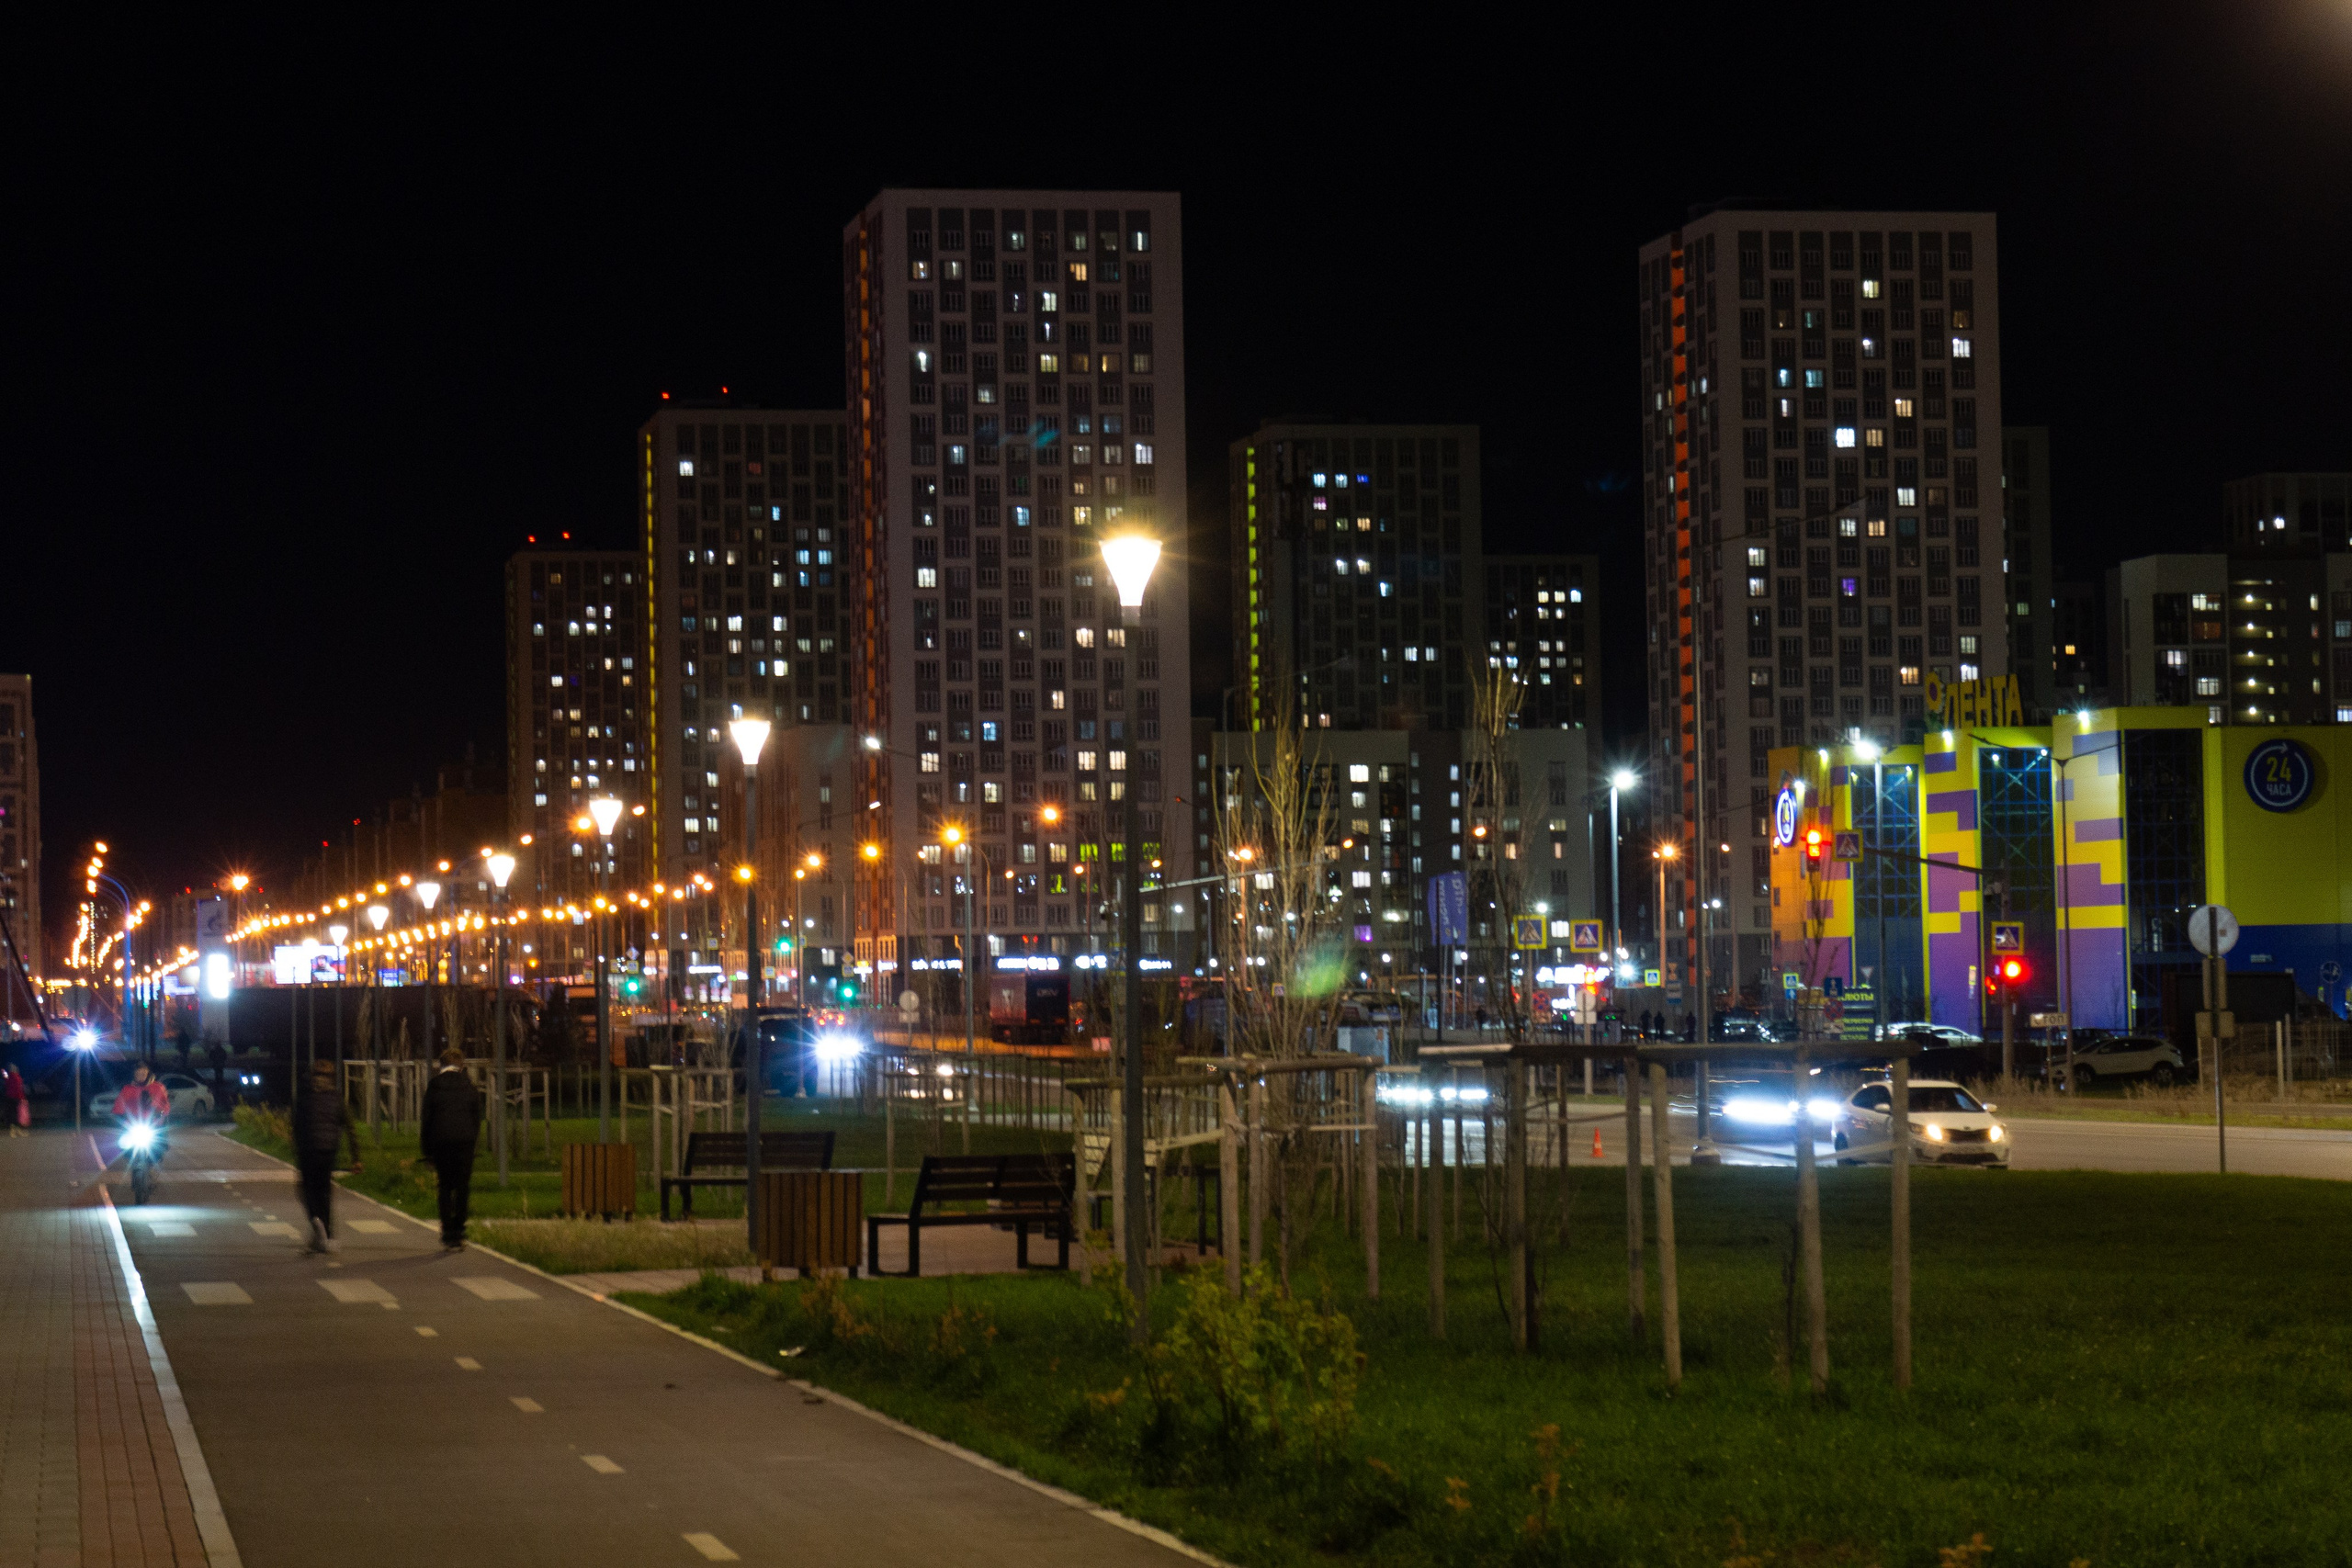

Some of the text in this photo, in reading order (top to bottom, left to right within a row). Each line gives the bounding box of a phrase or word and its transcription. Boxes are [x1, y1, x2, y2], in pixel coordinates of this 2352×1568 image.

[1944, 673, 2024, 729] ЛЕНТА
[2267, 757, 2292, 782] 24
[2267, 784, 2292, 795] ЧАСА
